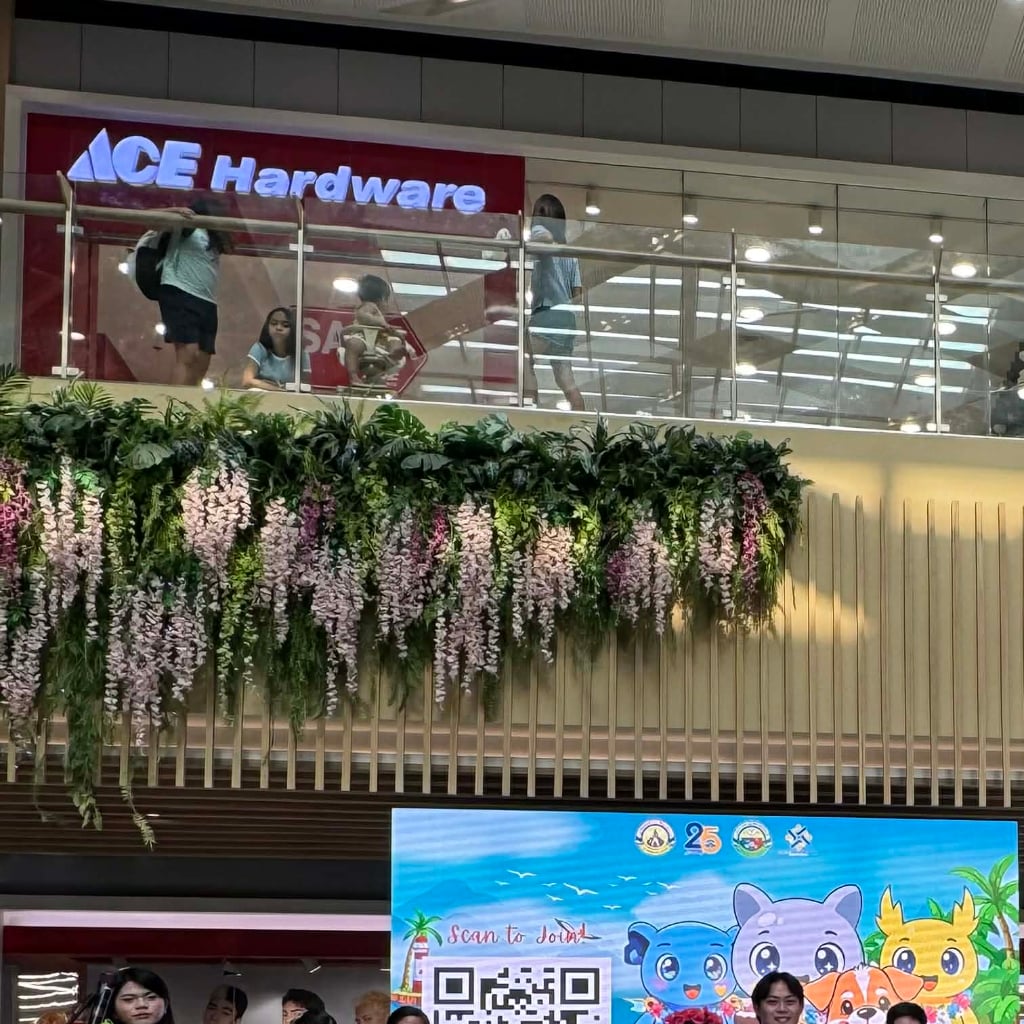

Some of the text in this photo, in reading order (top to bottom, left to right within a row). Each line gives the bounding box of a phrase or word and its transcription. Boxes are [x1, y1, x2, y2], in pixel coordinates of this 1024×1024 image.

[67, 127, 487, 215] ACE Hardware
[684, 821, 723, 855] 25
[447, 924, 500, 944] Scan
[505, 923, 526, 944] to
